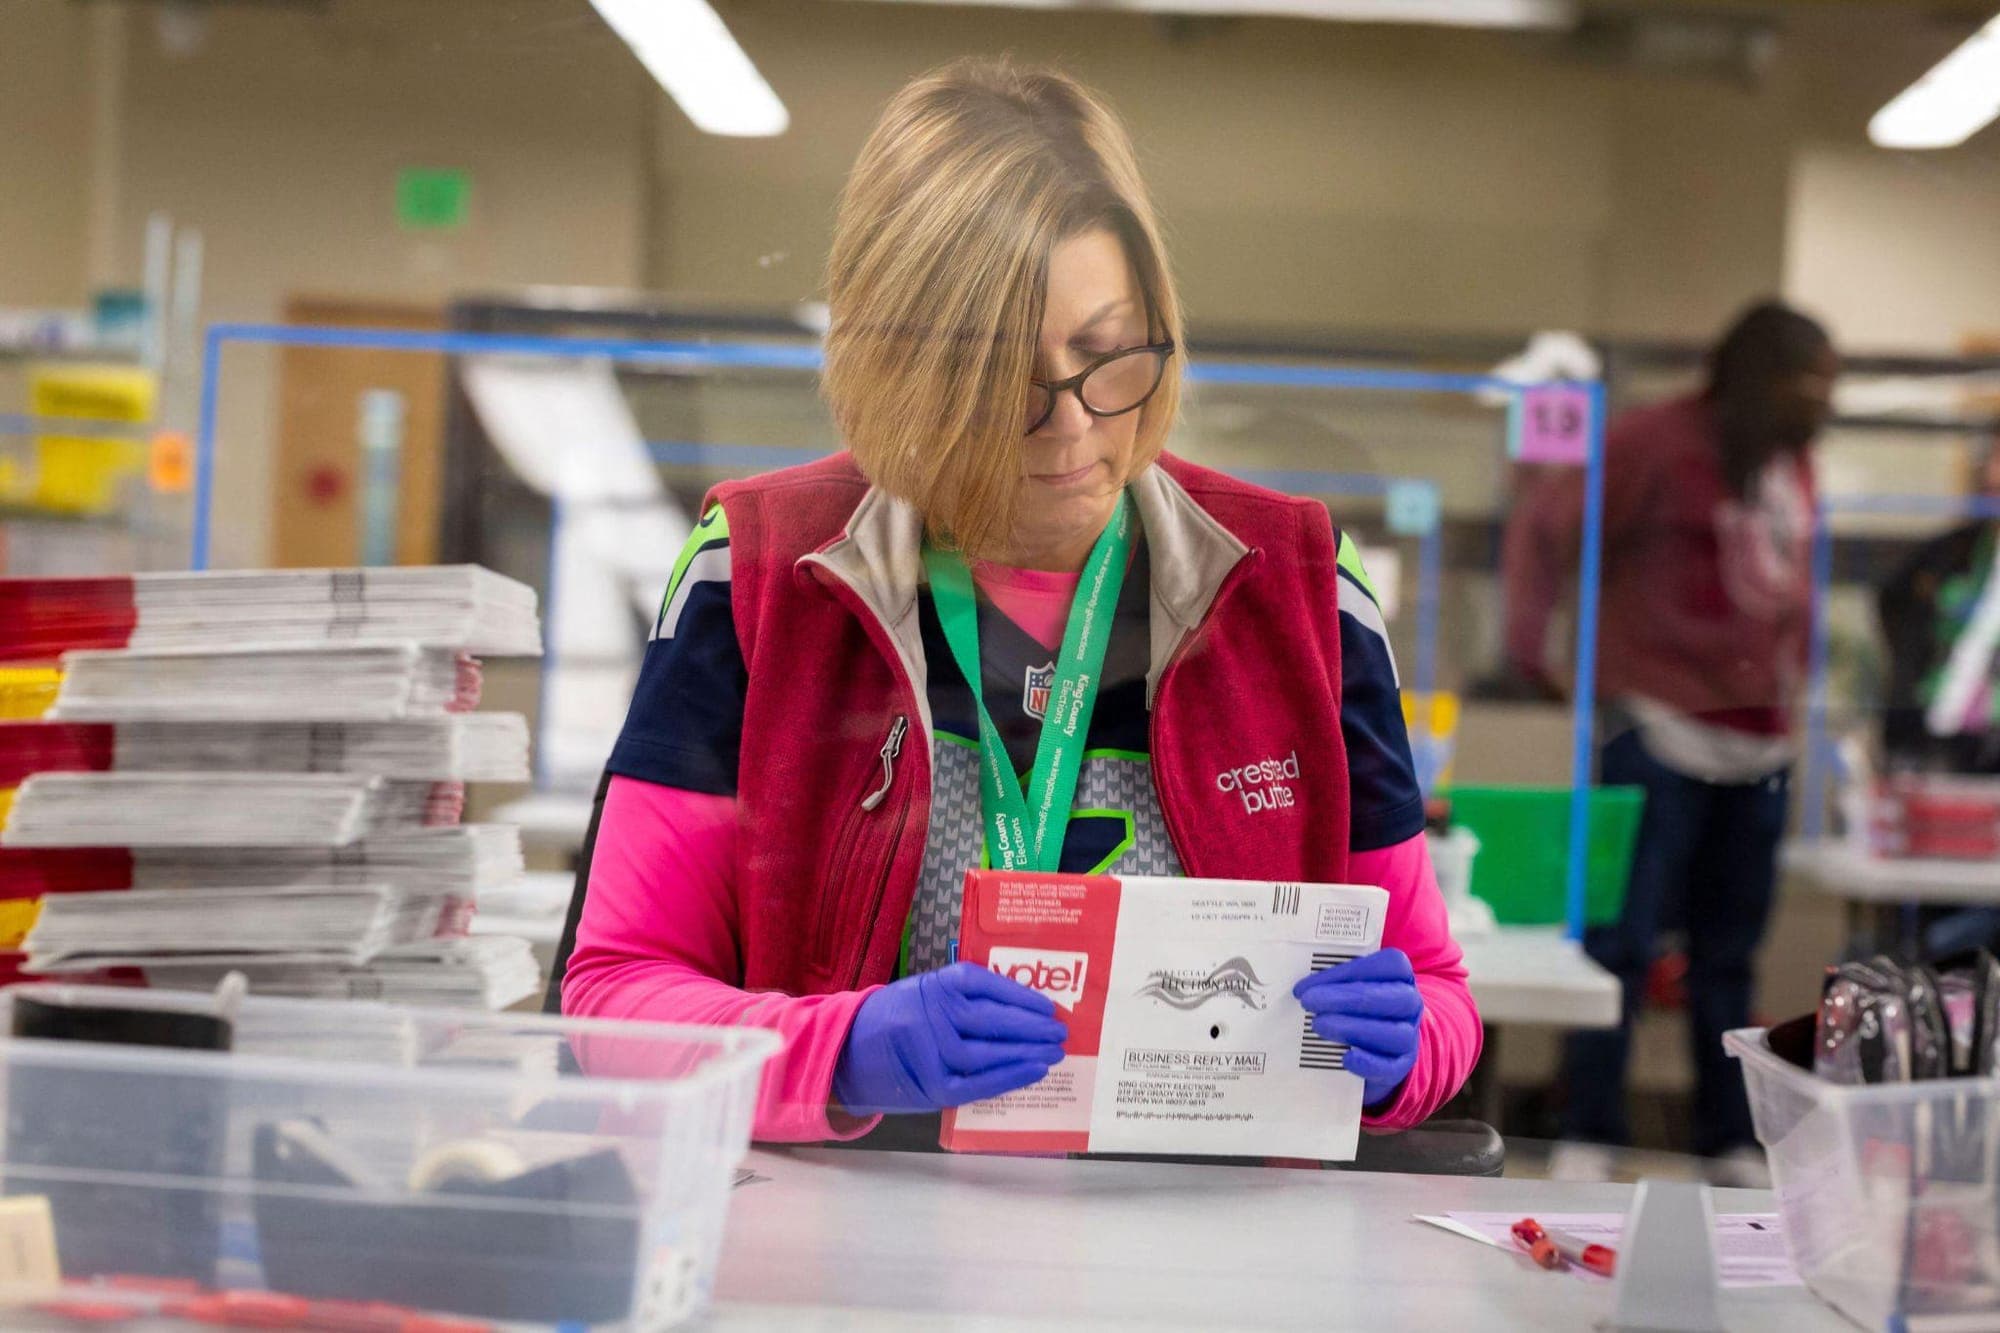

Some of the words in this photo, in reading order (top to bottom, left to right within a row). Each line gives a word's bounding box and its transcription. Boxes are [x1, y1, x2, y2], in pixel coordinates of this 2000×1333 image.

[1053, 679, 1074, 724] Elections
[1072, 674, 1090, 700] King
[1063, 700, 1084, 737] County
[1216, 749, 1300, 793] crested
[1241, 781, 1295, 816] butte
[995, 812, 1010, 850] County
[1011, 816, 1028, 865] Elections
[1128, 1052, 1191, 1064] BUSINESS
[1193, 1055, 1234, 1066] REPLY
[1234, 1055, 1261, 1066] MAIL
[1116, 1096, 1149, 1104] RENTON
[1118, 1080, 1138, 1088] KING
[1139, 1082, 1172, 1090] COUNTY
[1173, 1083, 1216, 1091] ELECTIONS
